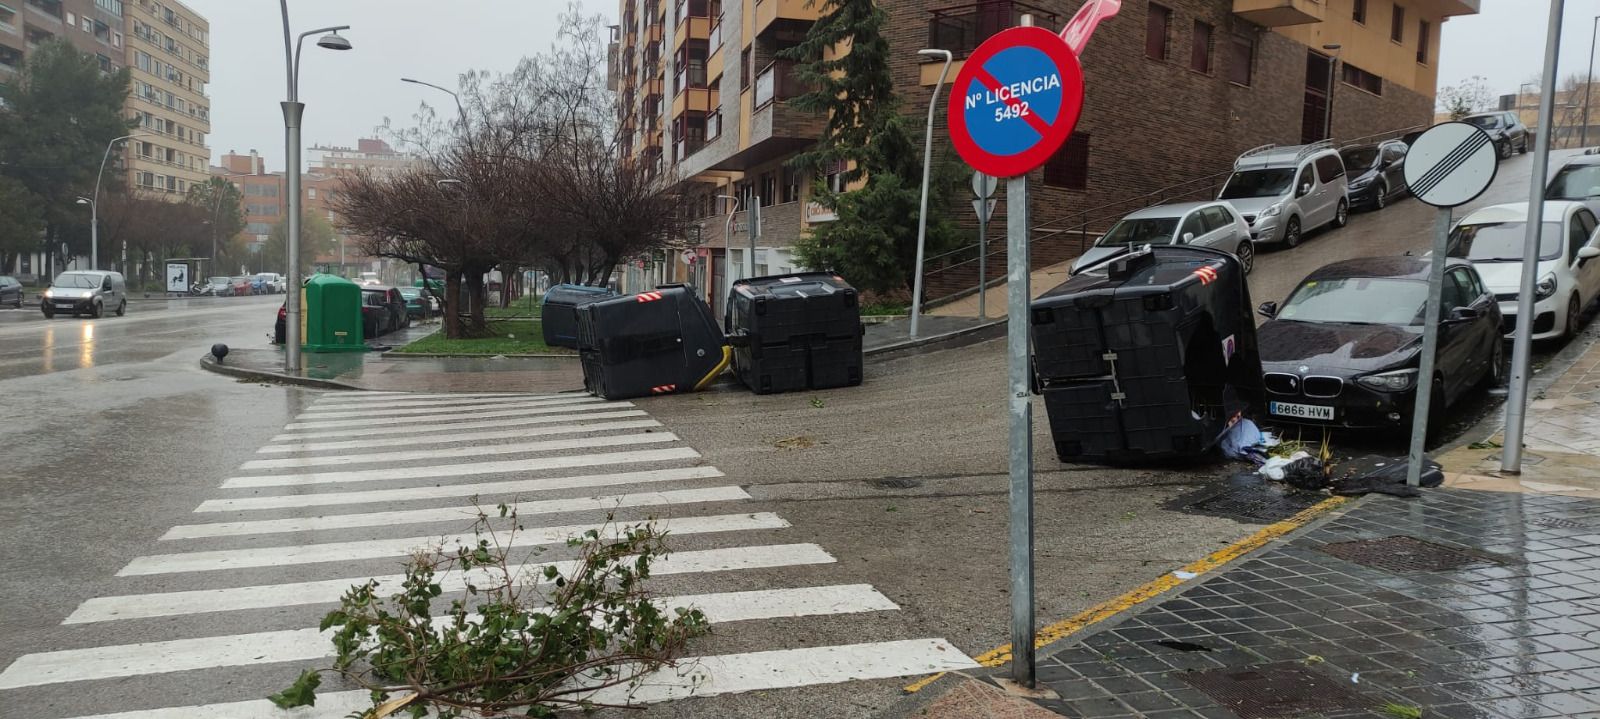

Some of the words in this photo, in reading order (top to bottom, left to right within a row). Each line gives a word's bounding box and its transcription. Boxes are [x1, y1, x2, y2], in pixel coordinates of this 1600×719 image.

[966, 93, 982, 110] Nº
[986, 73, 1060, 105] LICENCIA
[995, 101, 1029, 122] 5492
[1308, 407, 1330, 418] HVM
